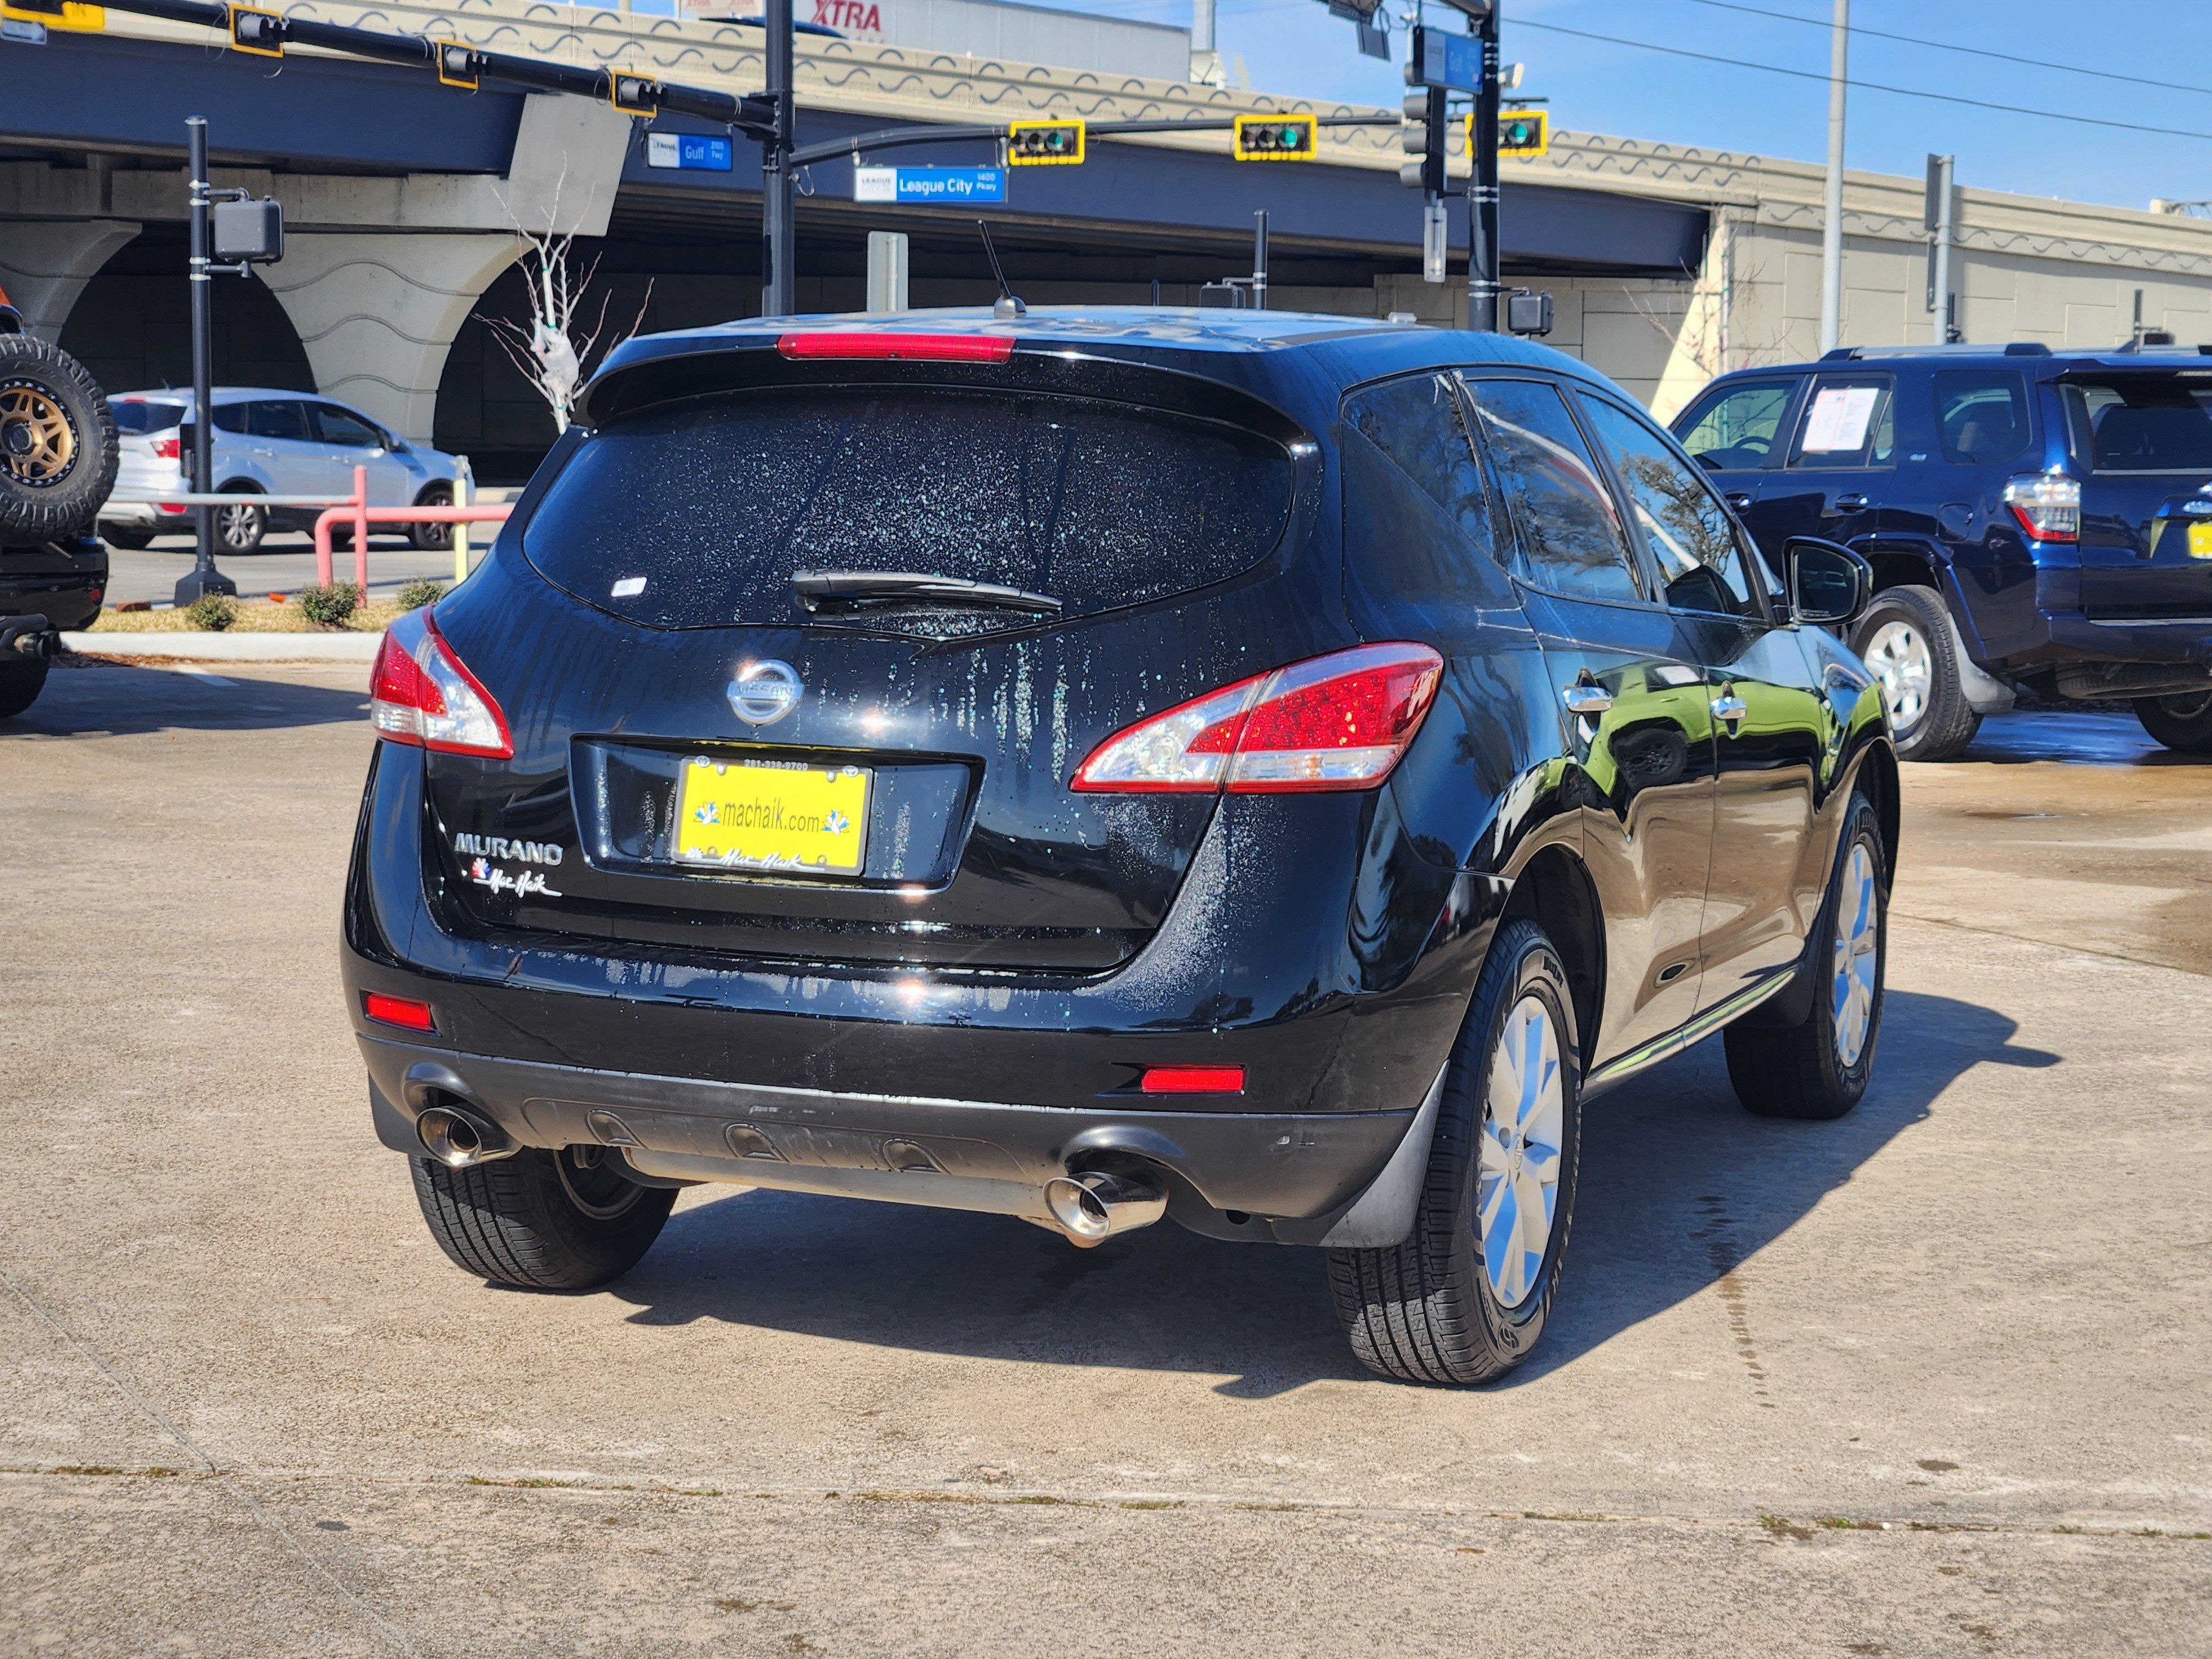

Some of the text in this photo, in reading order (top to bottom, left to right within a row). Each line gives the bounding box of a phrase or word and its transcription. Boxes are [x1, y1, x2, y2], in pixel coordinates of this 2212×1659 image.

[811, 0, 880, 32] XTRA
[685, 145, 704, 160] Gulf
[899, 178, 945, 196] League
[947, 178, 973, 195] City
[737, 685, 793, 696] NISSAN
[722, 797, 821, 832] machaik.com
[454, 832, 564, 866] MURANO
[702, 848, 756, 867] Mac
[473, 868, 563, 898] Mac Haik
